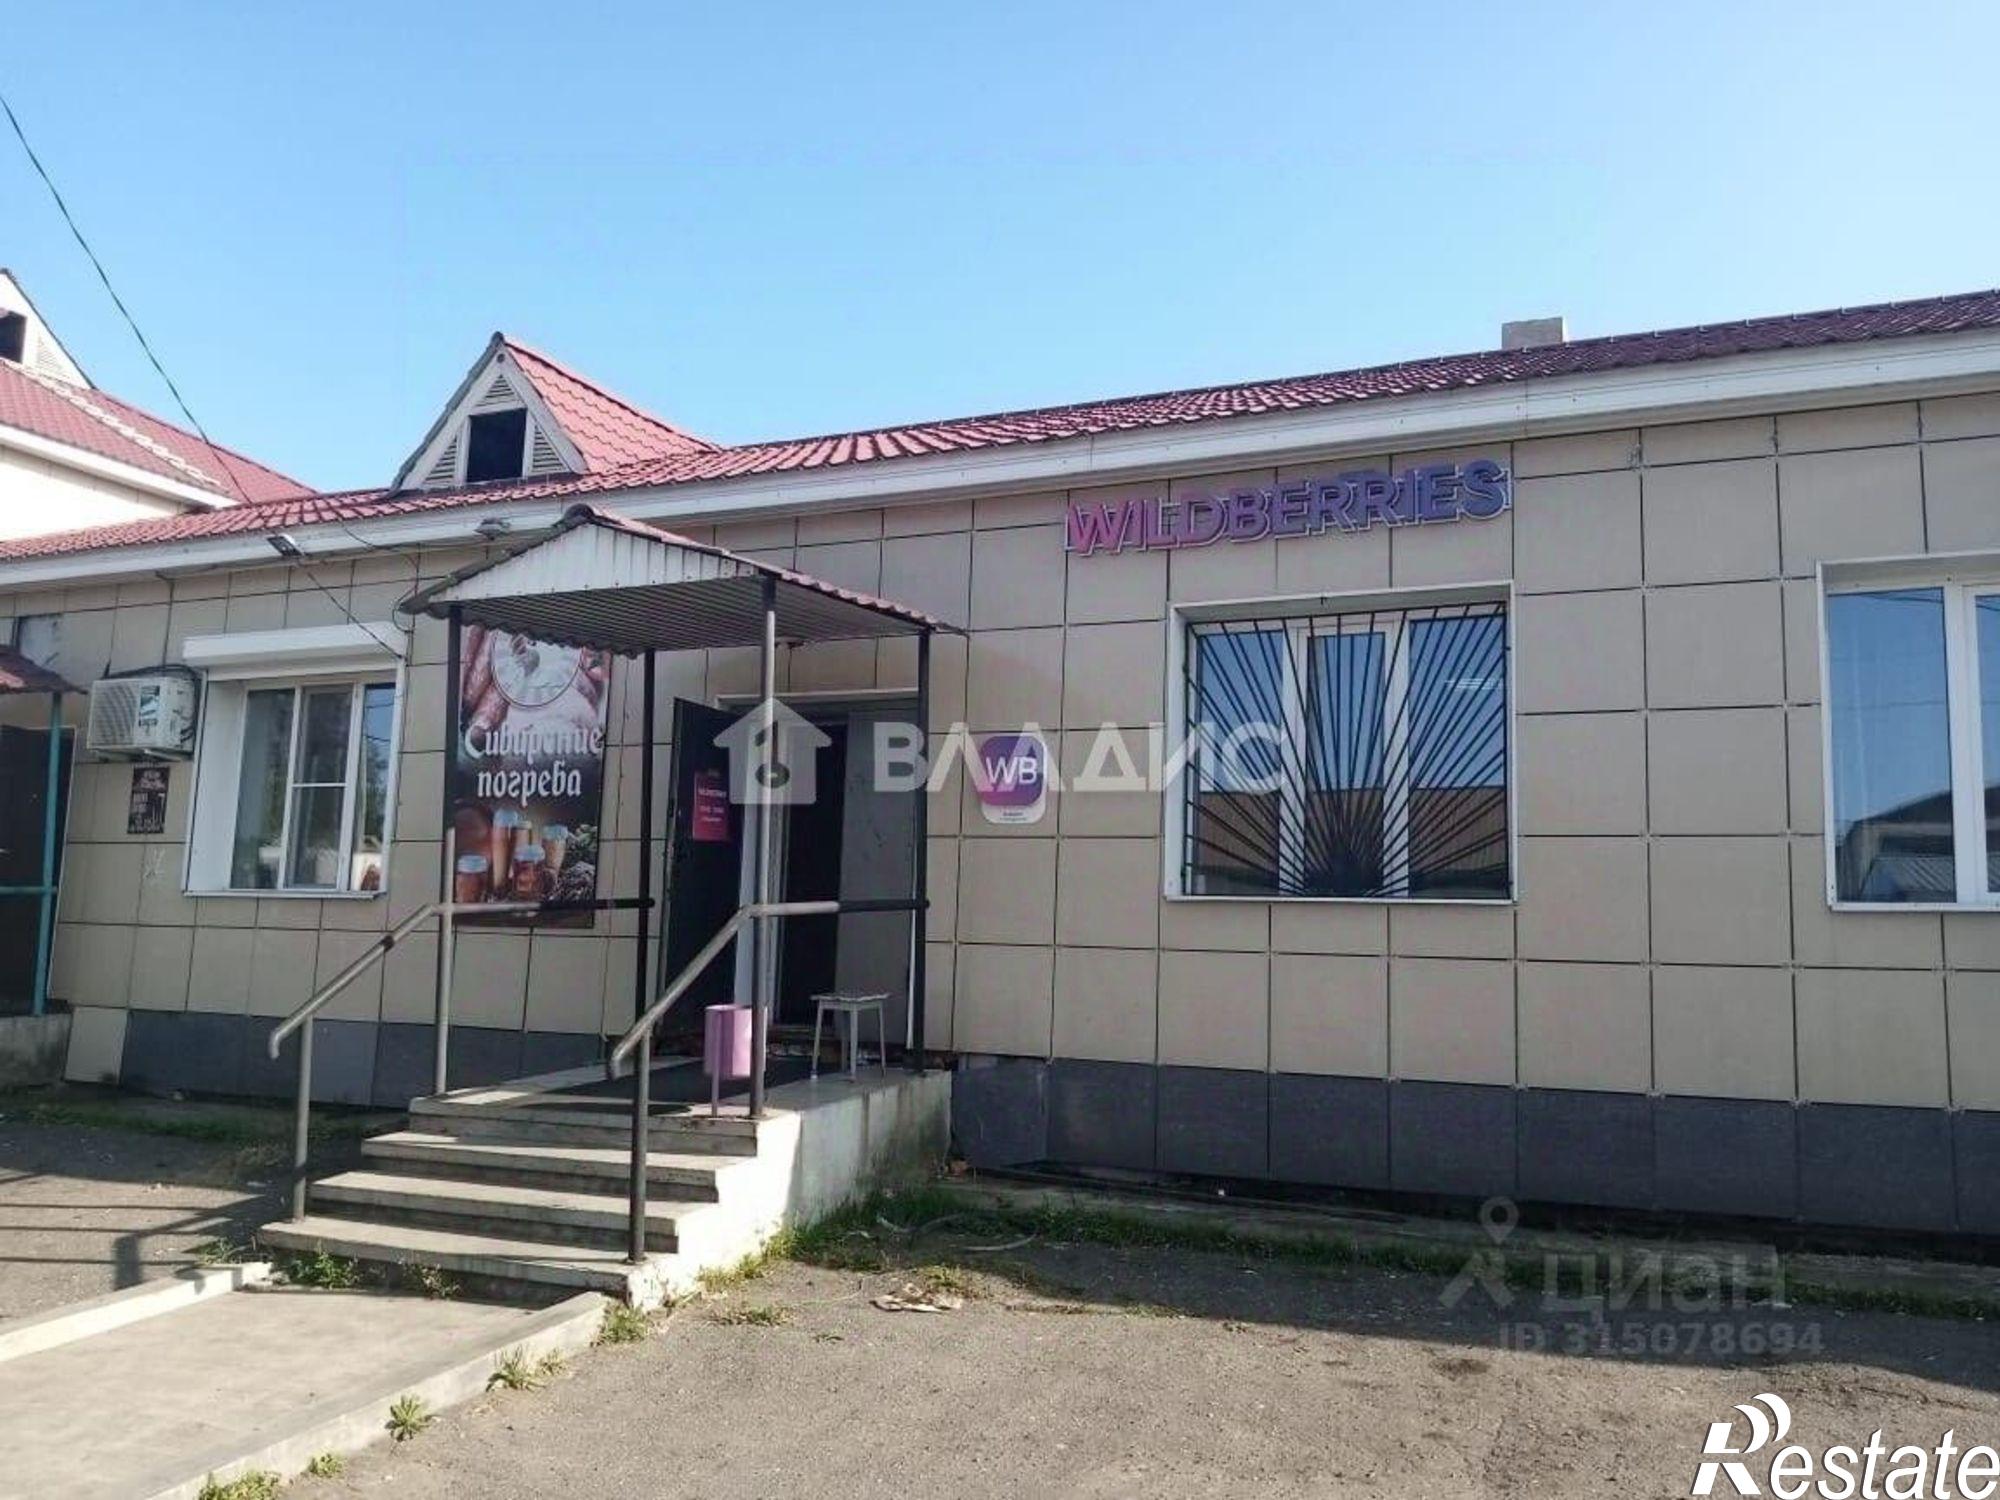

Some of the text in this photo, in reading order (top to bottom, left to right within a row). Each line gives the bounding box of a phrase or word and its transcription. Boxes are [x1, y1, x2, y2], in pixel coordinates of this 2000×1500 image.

[1065, 459, 1512, 556] WILDBERRIES
[477, 759, 581, 807] погреба
[985, 755, 1038, 784] WB
